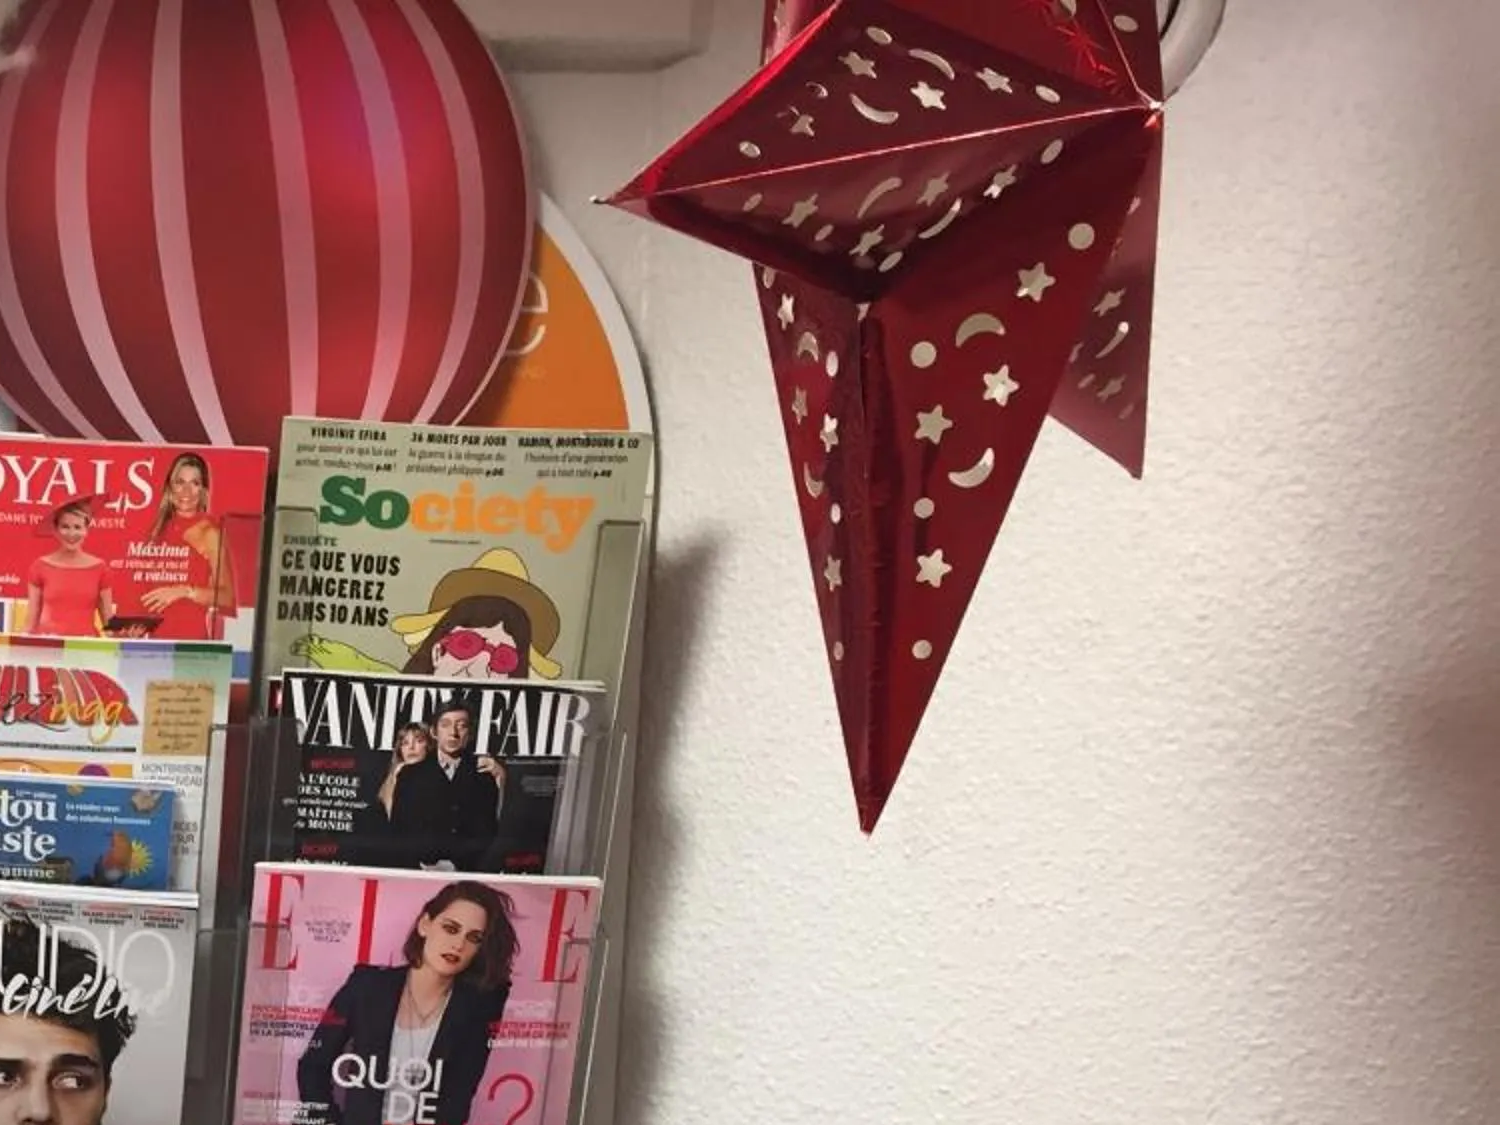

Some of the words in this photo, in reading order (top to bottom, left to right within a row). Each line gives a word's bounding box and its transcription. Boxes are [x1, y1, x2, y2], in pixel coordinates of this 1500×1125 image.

[311, 426, 354, 439] VIRGINIE
[358, 429, 387, 441] EFIRA
[426, 433, 459, 445] MORTS
[462, 434, 480, 445] PAR
[483, 436, 507, 446] JOUR
[319, 475, 596, 554] Society
[127, 541, 191, 557] Máxima
[281, 549, 306, 571] CE
[310, 550, 346, 572] QUE
[351, 552, 401, 577] VOUS
[279, 575, 385, 602] MANGEREZ
[277, 599, 327, 624] DANS
[329, 603, 348, 625] 10
[350, 605, 389, 628] ANS
[290, 676, 470, 752] VANIT
[474, 688, 591, 758] FAIR
[323, 786, 357, 798] ADOS
[308, 819, 354, 832] MONDE
[259, 872, 591, 983] ELE
[331, 1053, 445, 1093] QUOI
[387, 1091, 439, 1125] DE
